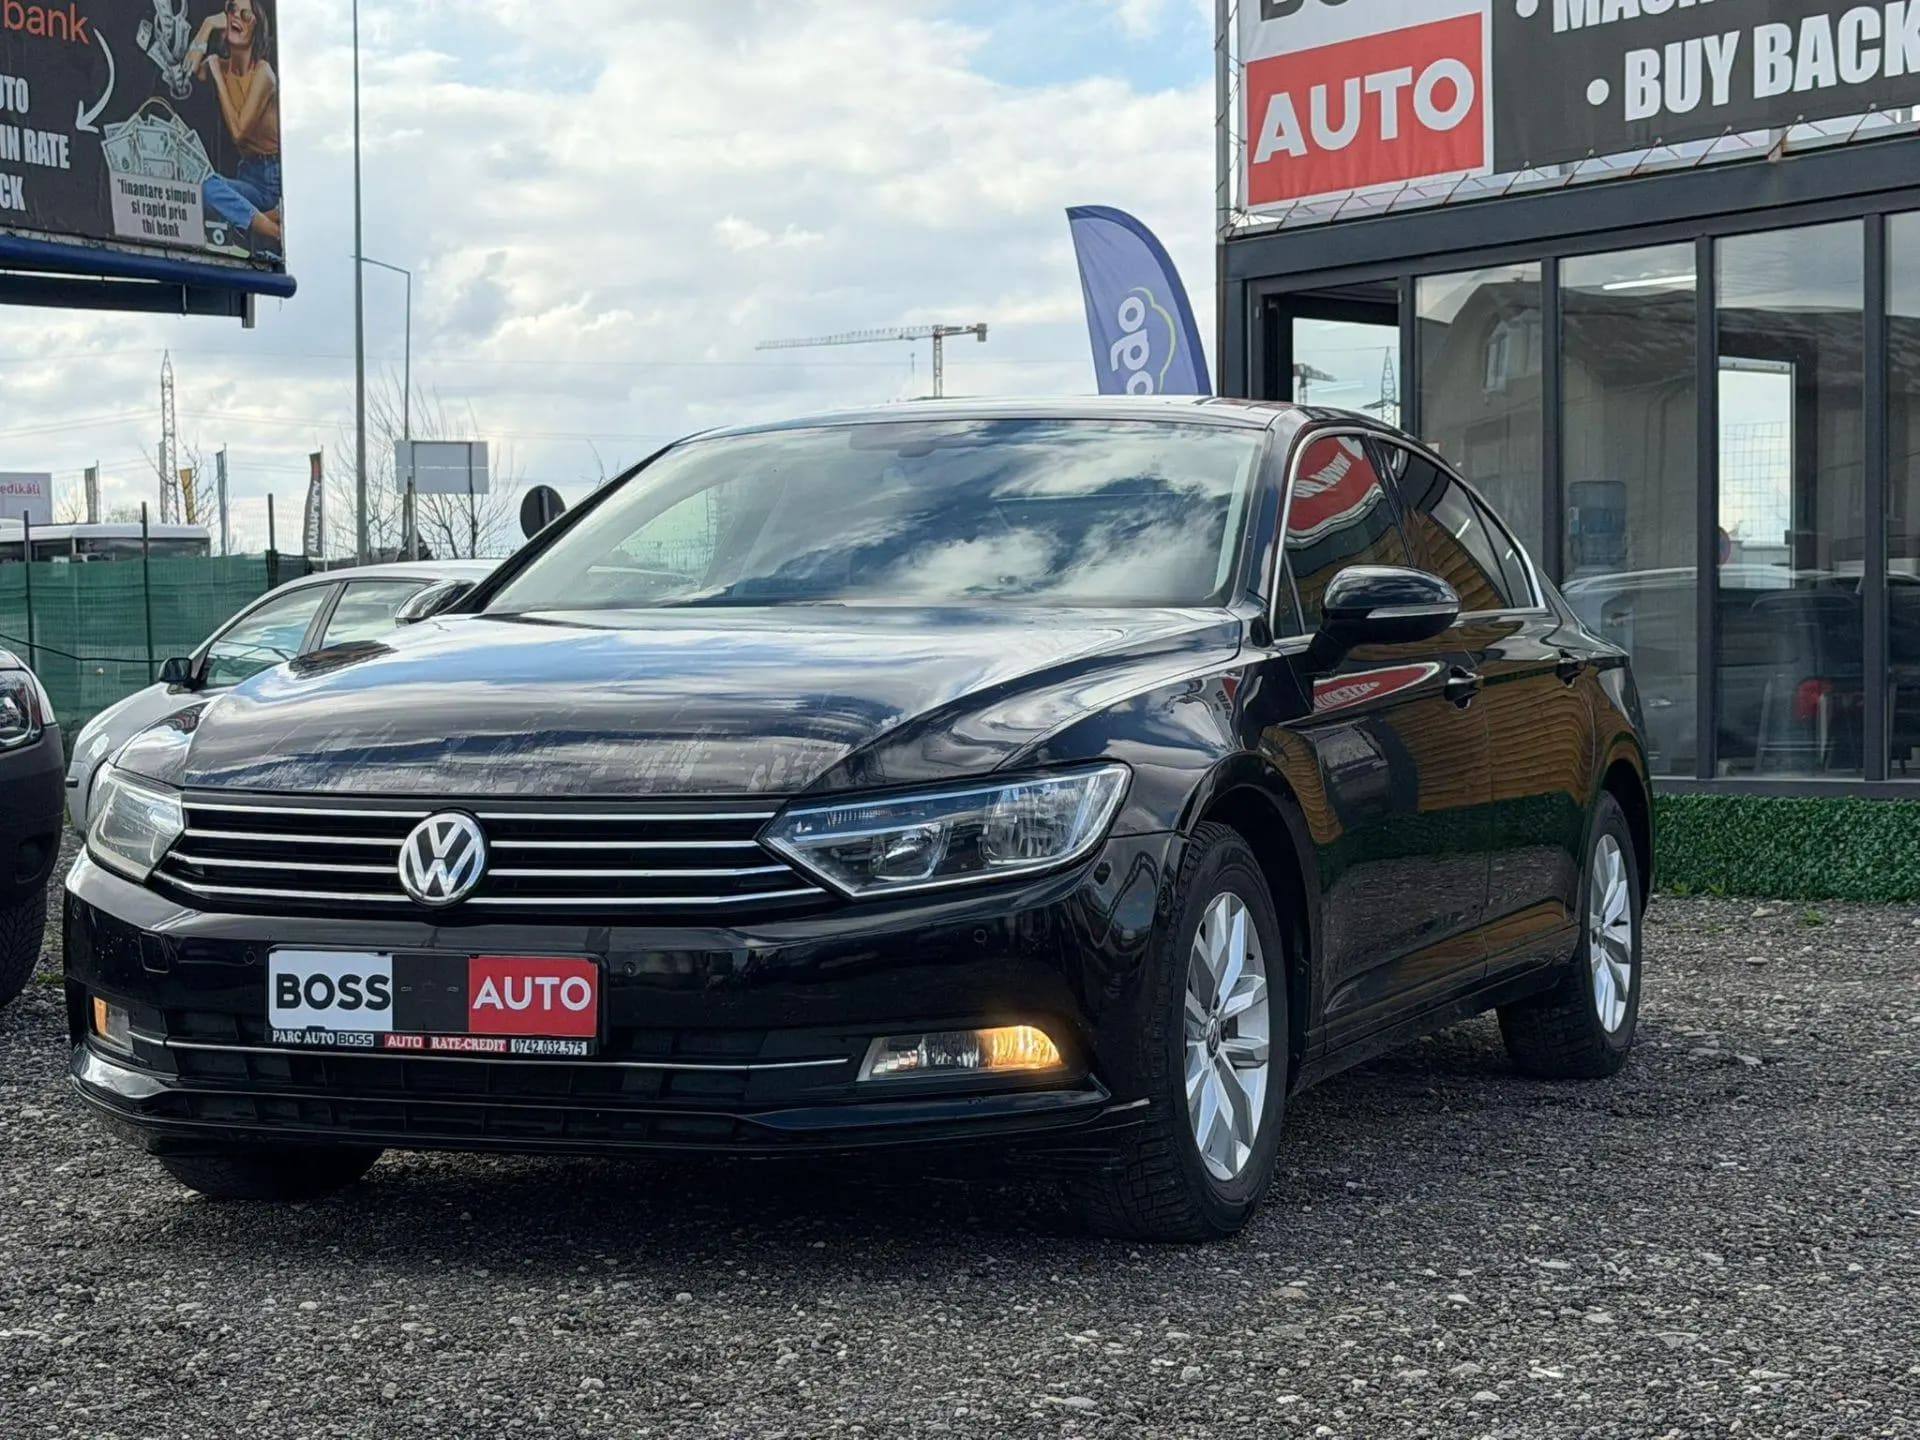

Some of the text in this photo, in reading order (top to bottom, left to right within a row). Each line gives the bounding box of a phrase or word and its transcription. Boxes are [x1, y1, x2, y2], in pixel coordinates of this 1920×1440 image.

[4, 0, 89, 44] bank
[1624, 0, 1920, 121] BUY BACK
[1253, 58, 1475, 164] AUTO
[24, 129, 70, 169] RATE
[131, 200, 188, 221] si rapid prin
[165, 186, 197, 205] simplu
[157, 220, 181, 237] bank
[276, 973, 591, 1011] BOSS AUTO
[272, 1030, 302, 1044] PARC
[303, 1031, 335, 1045] AUTO
[338, 1033, 373, 1046] BOSS
[388, 1035, 422, 1048] AUTO
[431, 1036, 507, 1052] RATE-CREDIT
